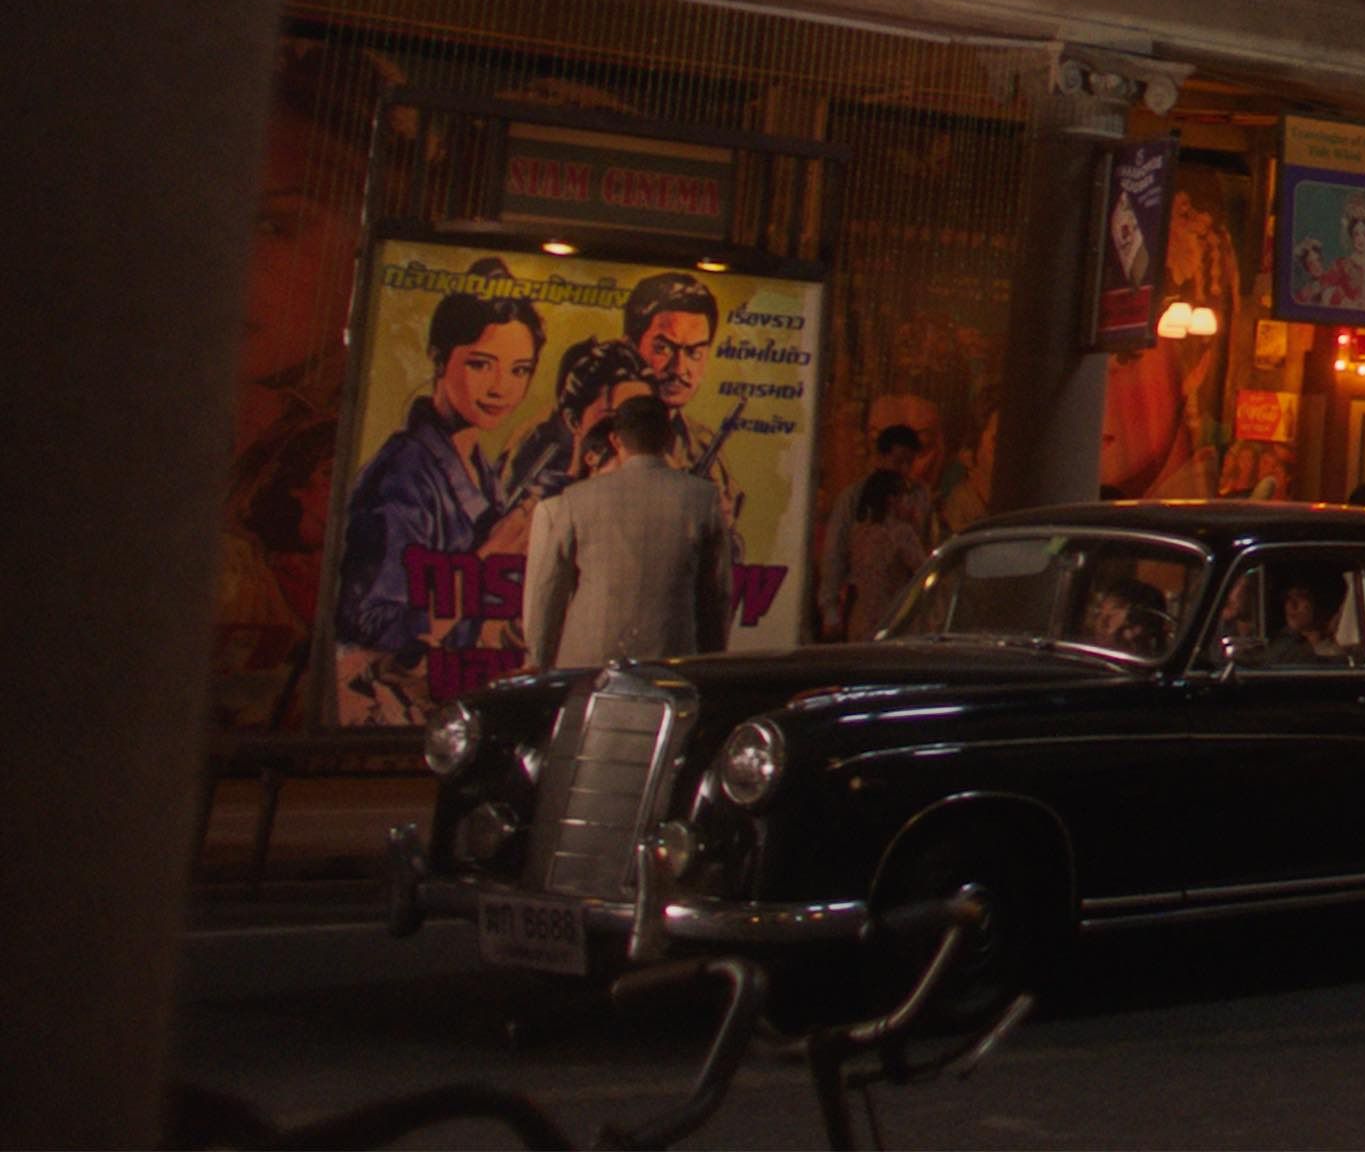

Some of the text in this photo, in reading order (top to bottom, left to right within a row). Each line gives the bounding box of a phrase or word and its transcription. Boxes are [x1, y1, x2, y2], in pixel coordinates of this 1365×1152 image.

[505, 156, 724, 219] SIAM CINEMA
[726, 300, 806, 330] เรื่องราว
